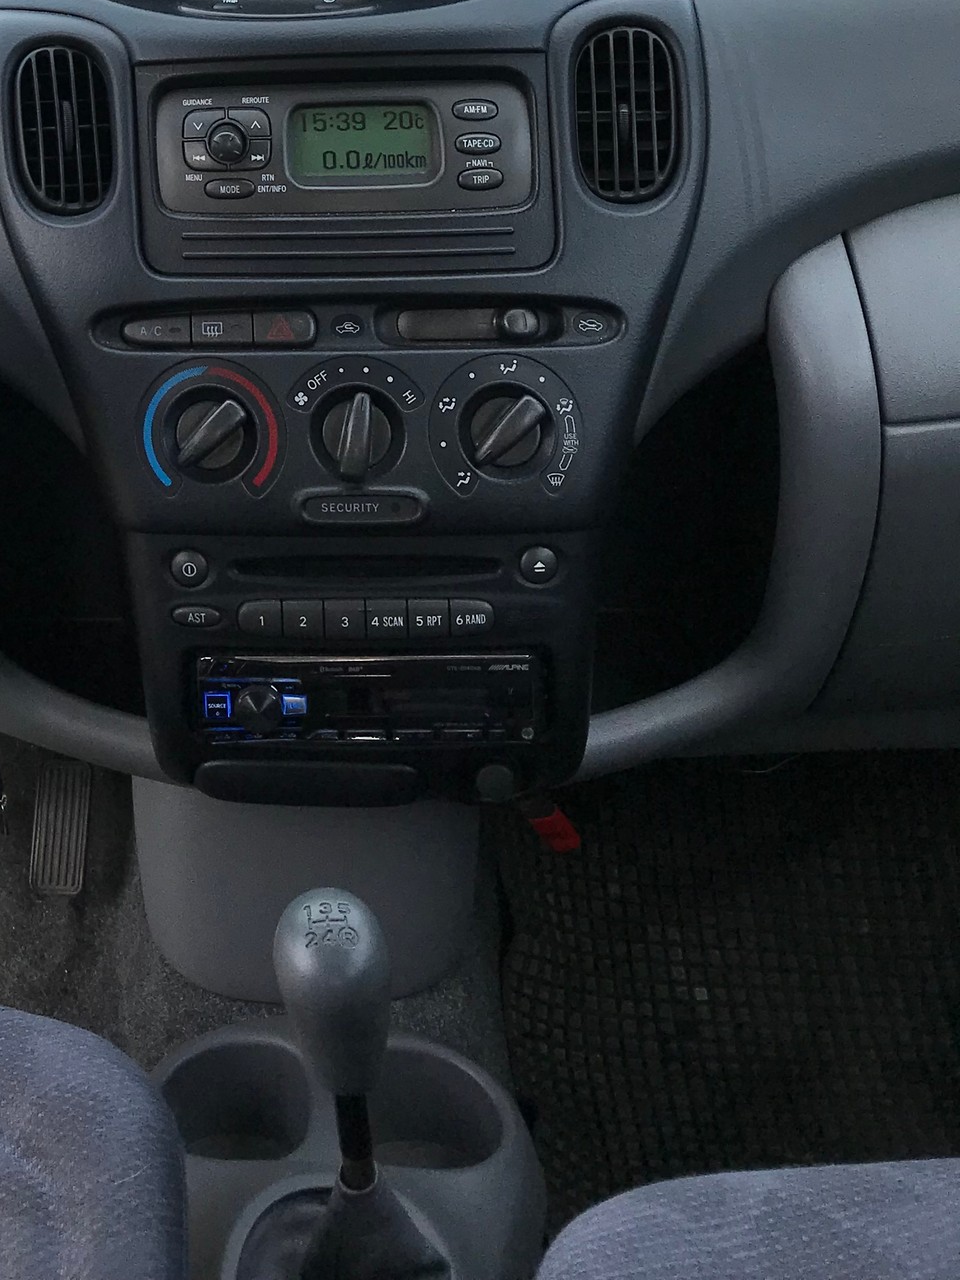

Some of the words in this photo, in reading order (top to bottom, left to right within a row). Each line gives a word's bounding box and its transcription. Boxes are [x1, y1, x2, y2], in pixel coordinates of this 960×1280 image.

[182, 98, 212, 106] GUIDANCE
[242, 96, 269, 104] REROUTE
[302, 112, 366, 132] 15:39
[471, 159, 488, 167] NAVI
[473, 175, 490, 184] TRIP
[220, 185, 240, 194] MODE
[257, 185, 286, 193] ENT/INFO
[140, 325, 162, 336] A/C
[307, 370, 328, 390] OFF
[402, 389, 417, 404] HI
[321, 503, 379, 513] SECURITY
[187, 613, 206, 623] AST
[259, 616, 265, 626] 1
[299, 616, 307, 627] 2
[341, 616, 349, 627] 3
[371, 616, 380, 626] 4
[382, 616, 404, 627] SCAN
[416, 616, 424, 626] 5
[427, 615, 442, 626] RPT
[455, 615, 463, 625] 6
[465, 614, 486, 625] RAND
